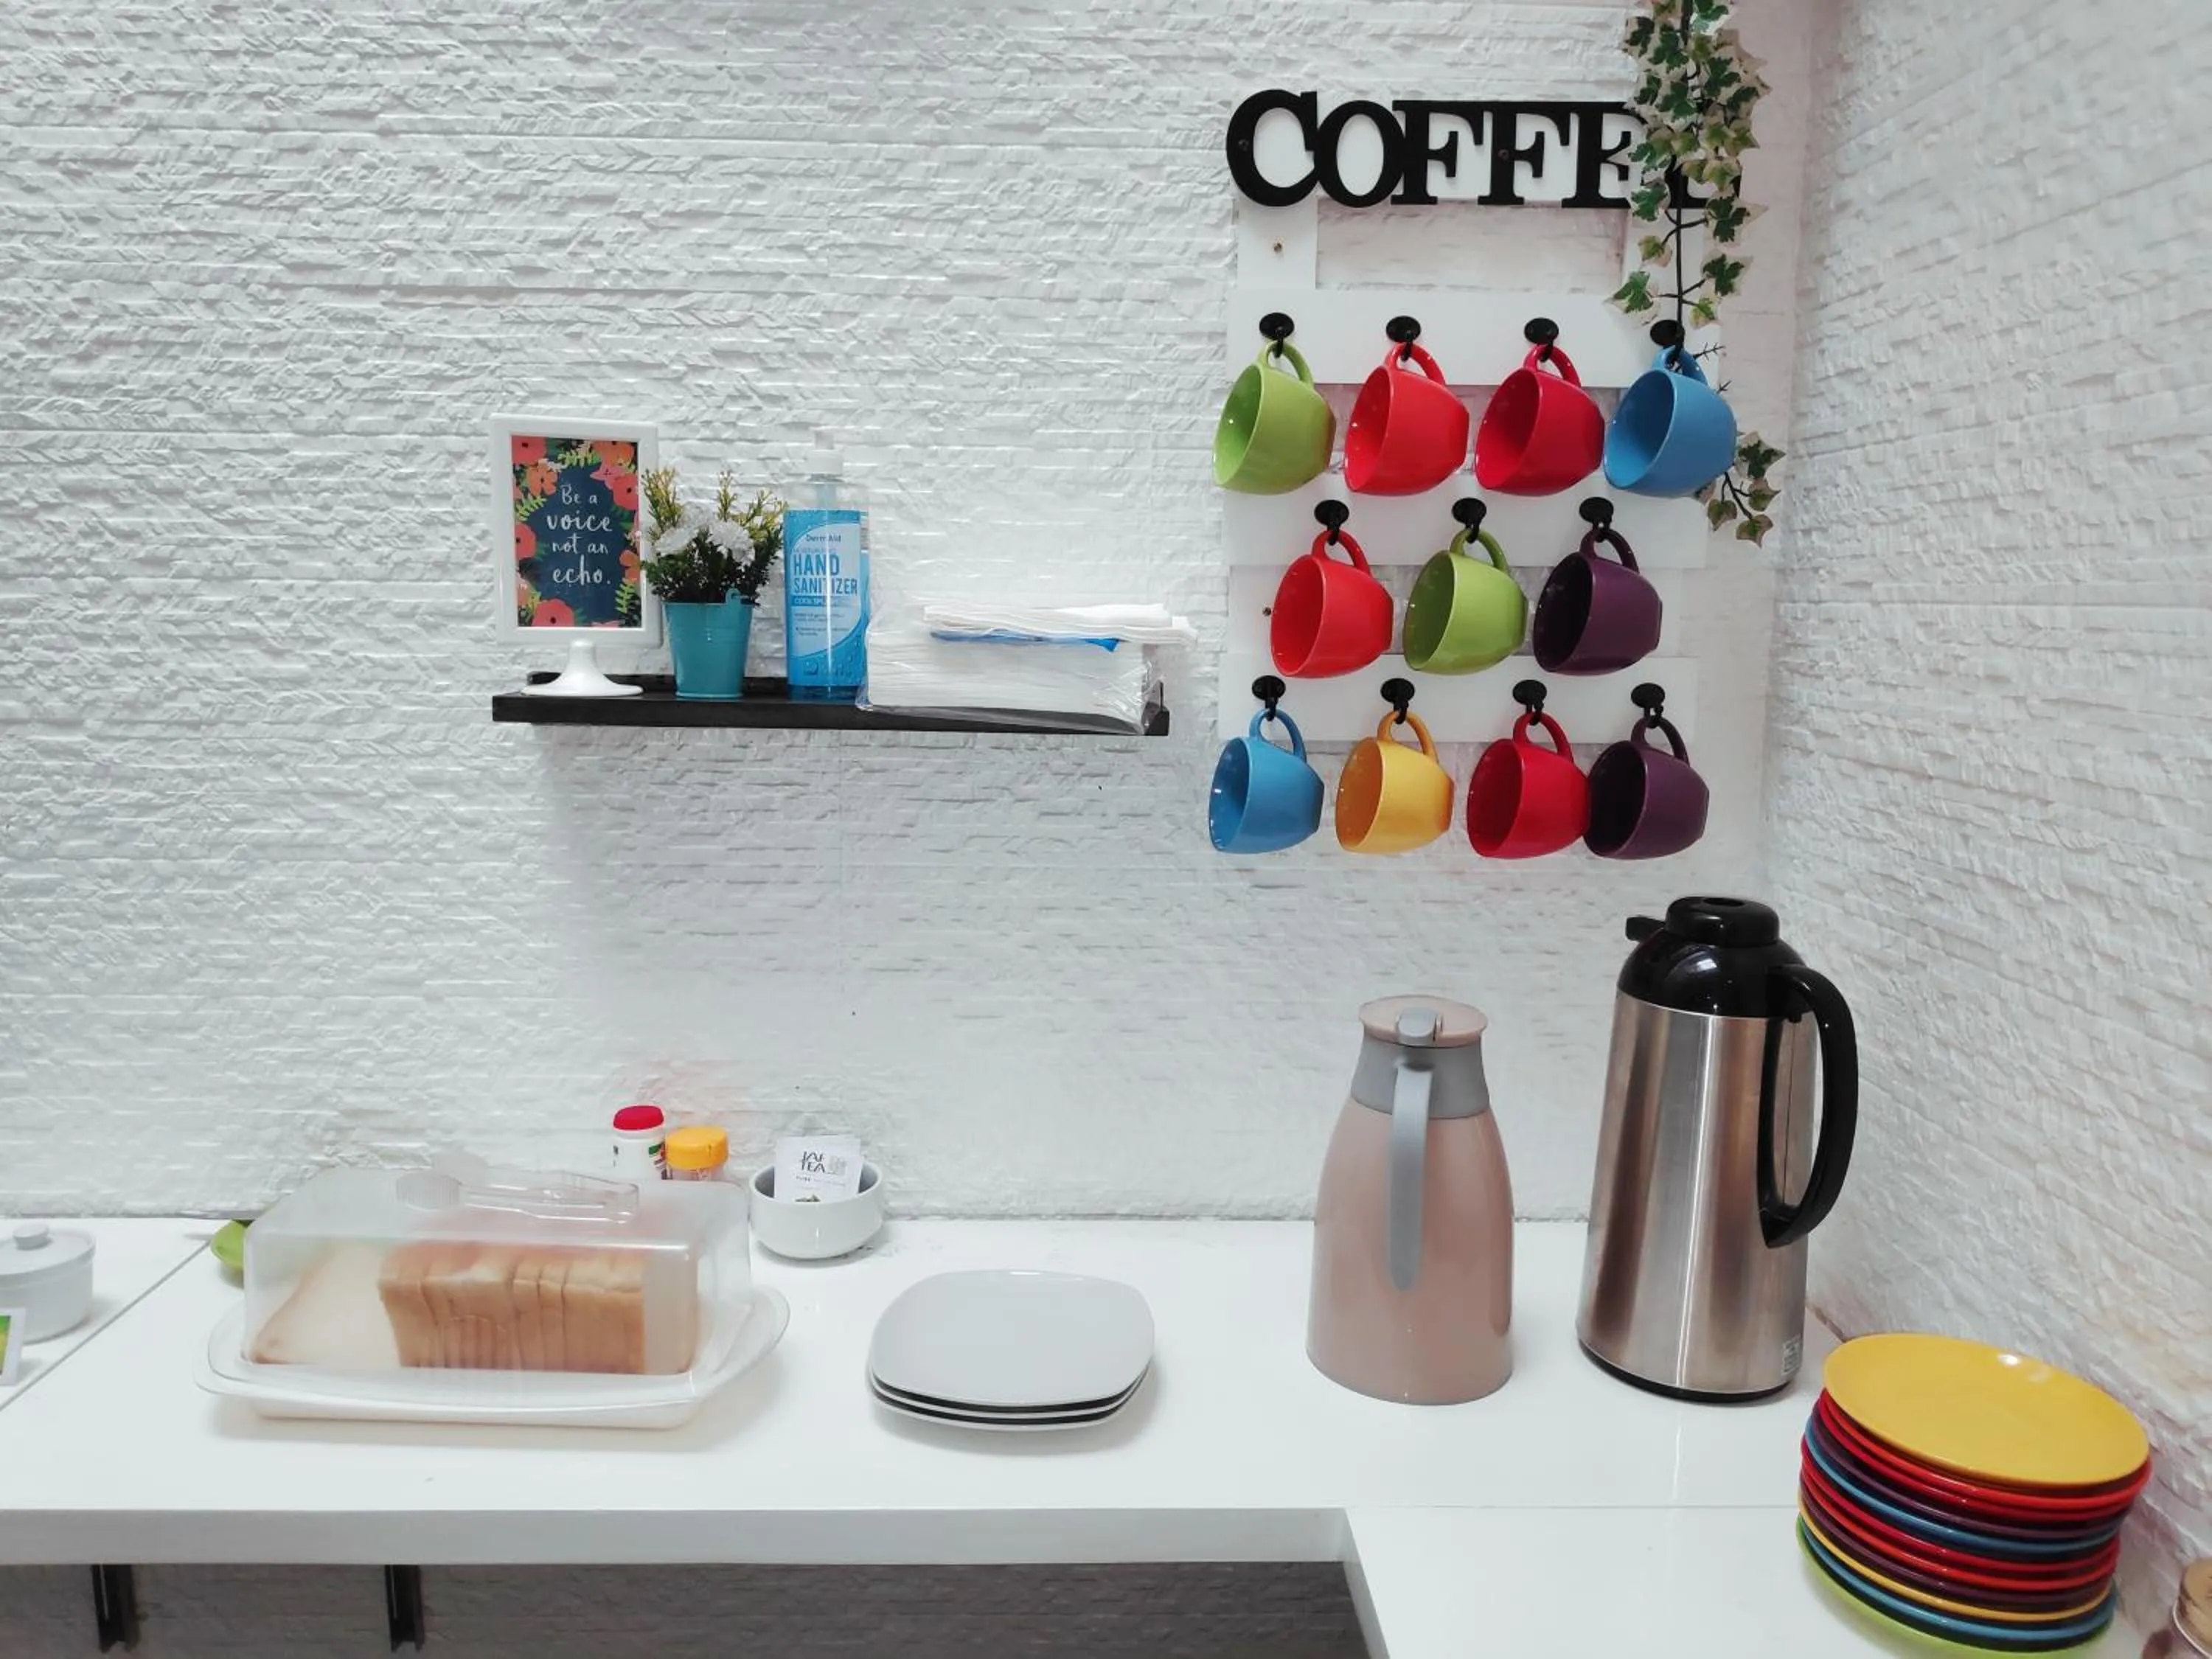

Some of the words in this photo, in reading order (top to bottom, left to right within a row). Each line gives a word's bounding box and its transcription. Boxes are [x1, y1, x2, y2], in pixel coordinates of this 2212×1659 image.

[560, 484, 582, 504] Be
[589, 493, 598, 504] a
[546, 510, 613, 532] voice
[552, 532, 582, 554] not
[587, 542, 609, 554] an
[552, 554, 611, 586] echo.
[794, 554, 840, 576] HAND
